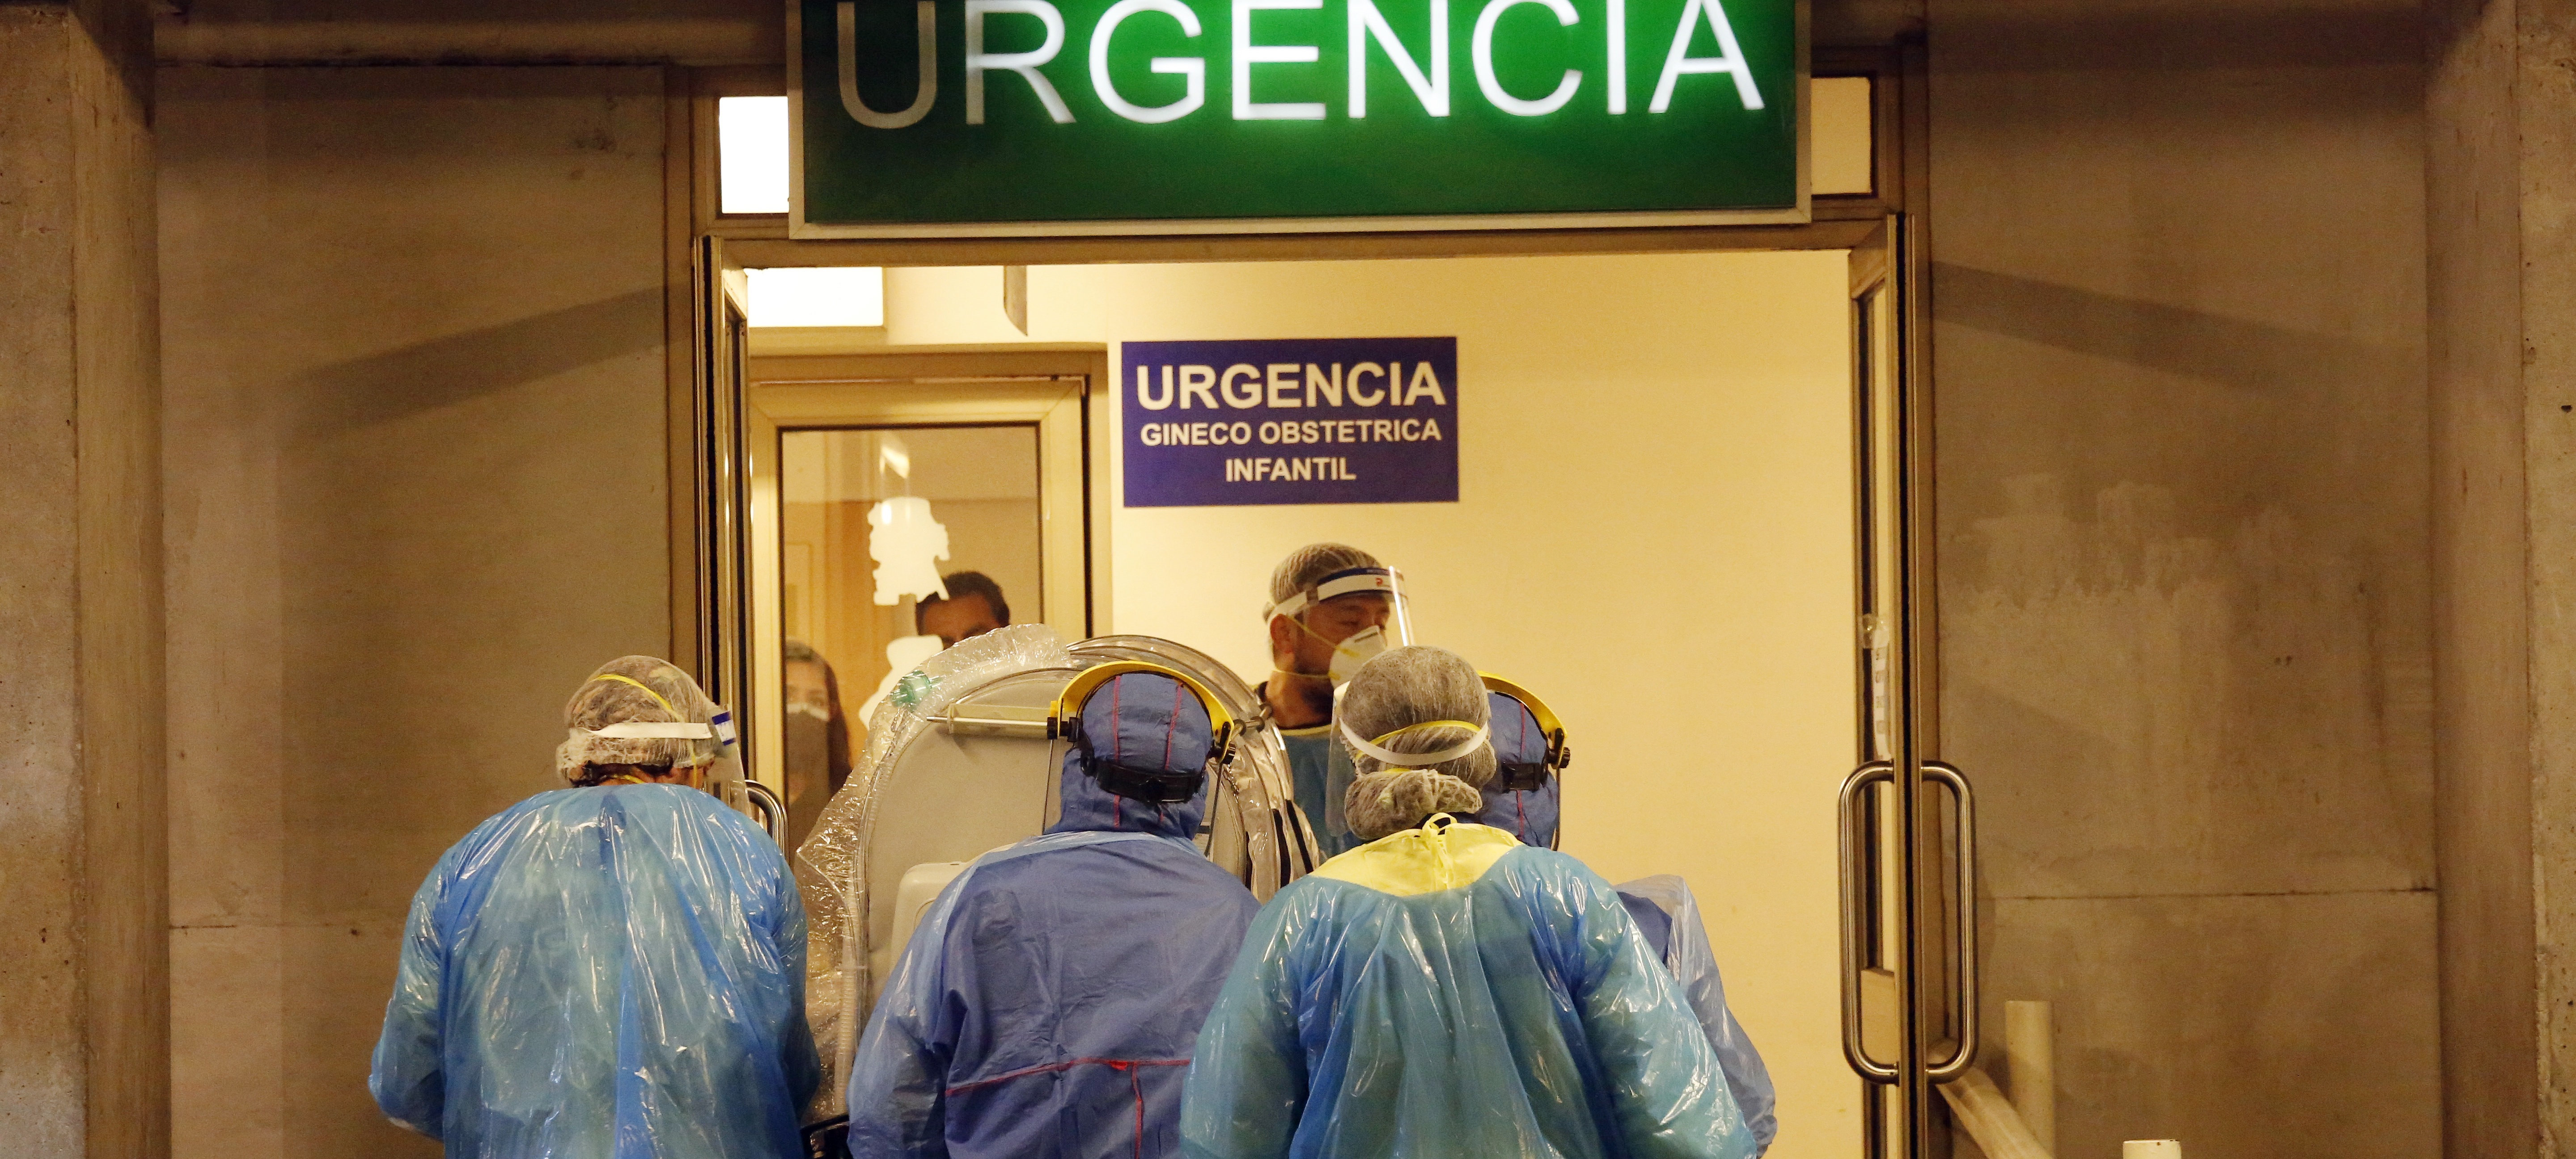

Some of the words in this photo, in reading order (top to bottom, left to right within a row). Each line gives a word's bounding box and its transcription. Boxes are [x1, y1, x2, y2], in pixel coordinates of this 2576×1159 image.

[836, 0, 1765, 129] URGENCIA
[1136, 361, 1446, 410] URGENCIA
[1140, 422, 1252, 446] GINECO
[1258, 419, 1442, 444] OBSTETRICA
[1225, 457, 1357, 482] INFANTIL
